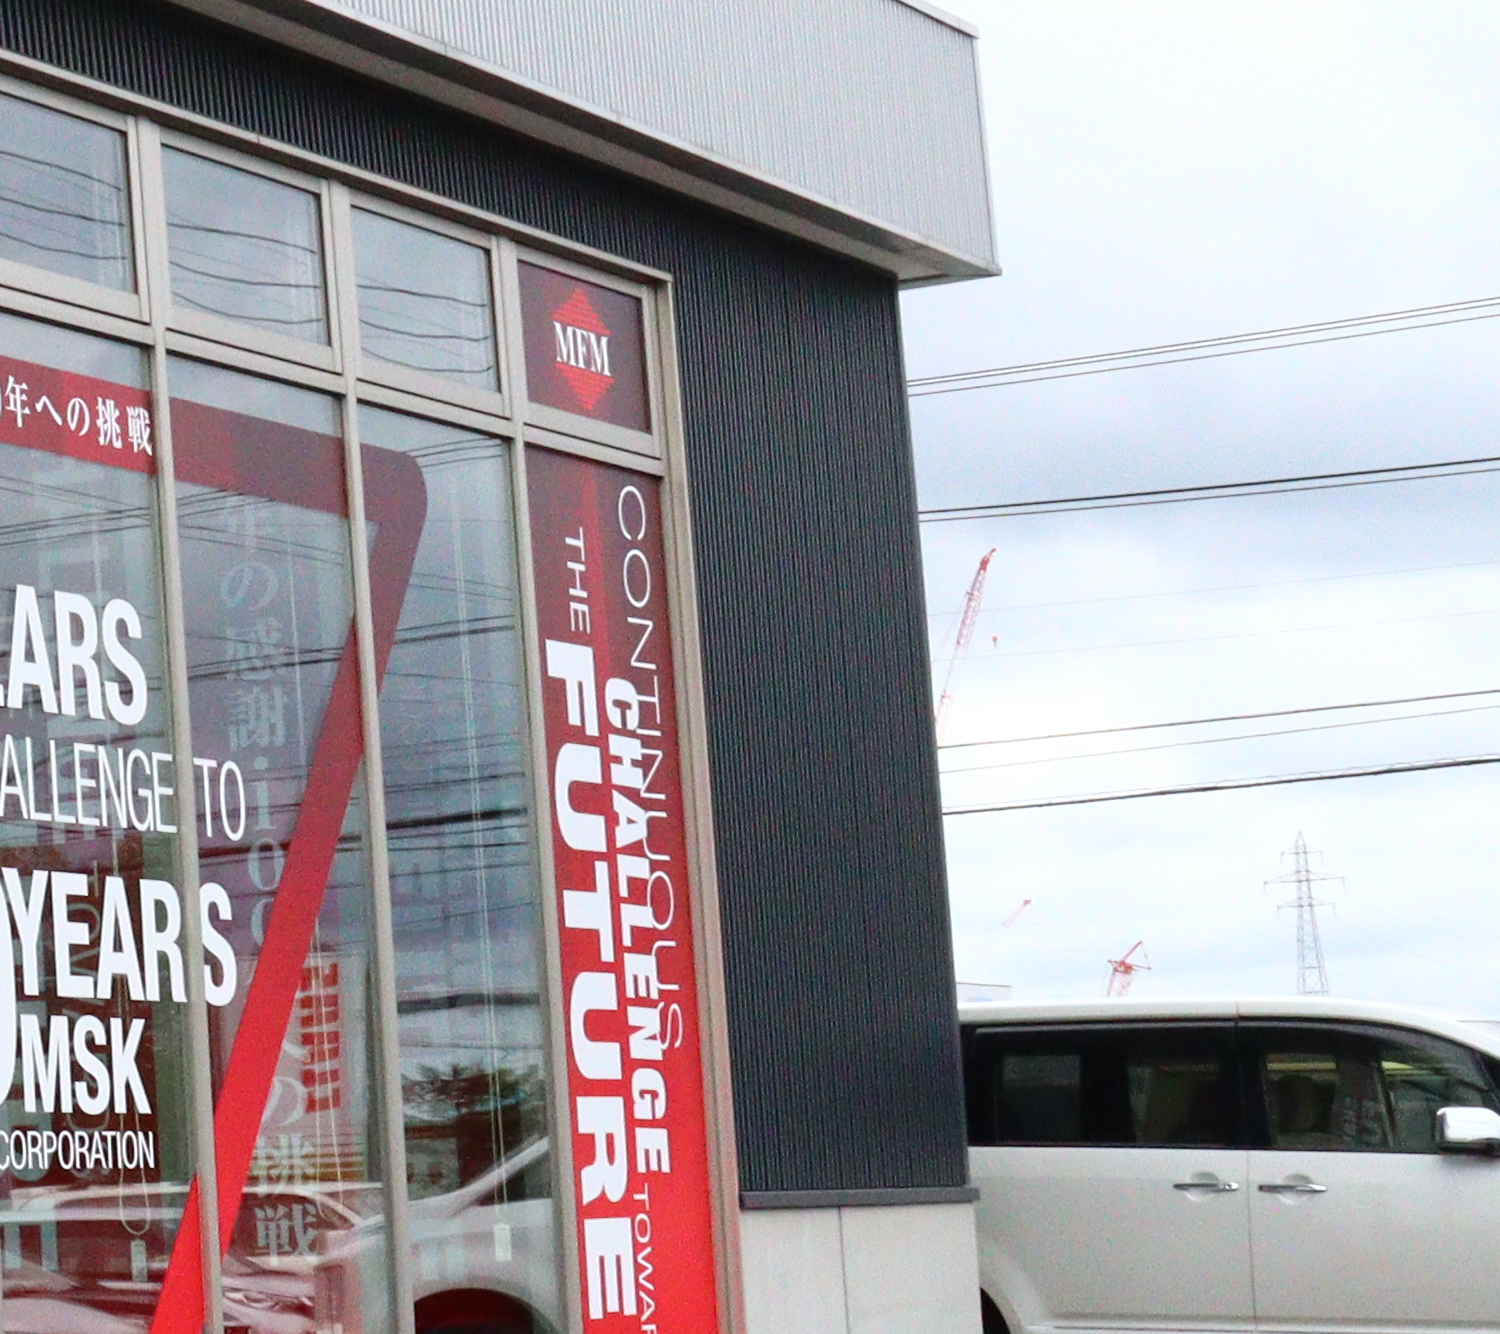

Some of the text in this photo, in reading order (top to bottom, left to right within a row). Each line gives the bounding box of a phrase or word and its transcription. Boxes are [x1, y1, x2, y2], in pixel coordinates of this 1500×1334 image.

[553, 321, 611, 376] MFM
[564, 527, 592, 635] THE
[193, 757, 247, 842] TO
[617, 484, 683, 1051] CONTINUOUS
[545, 638, 638, 1320] FUTURE
[604, 677, 671, 1174] CHALLENGE
[19, 1013, 152, 1116] MSK
